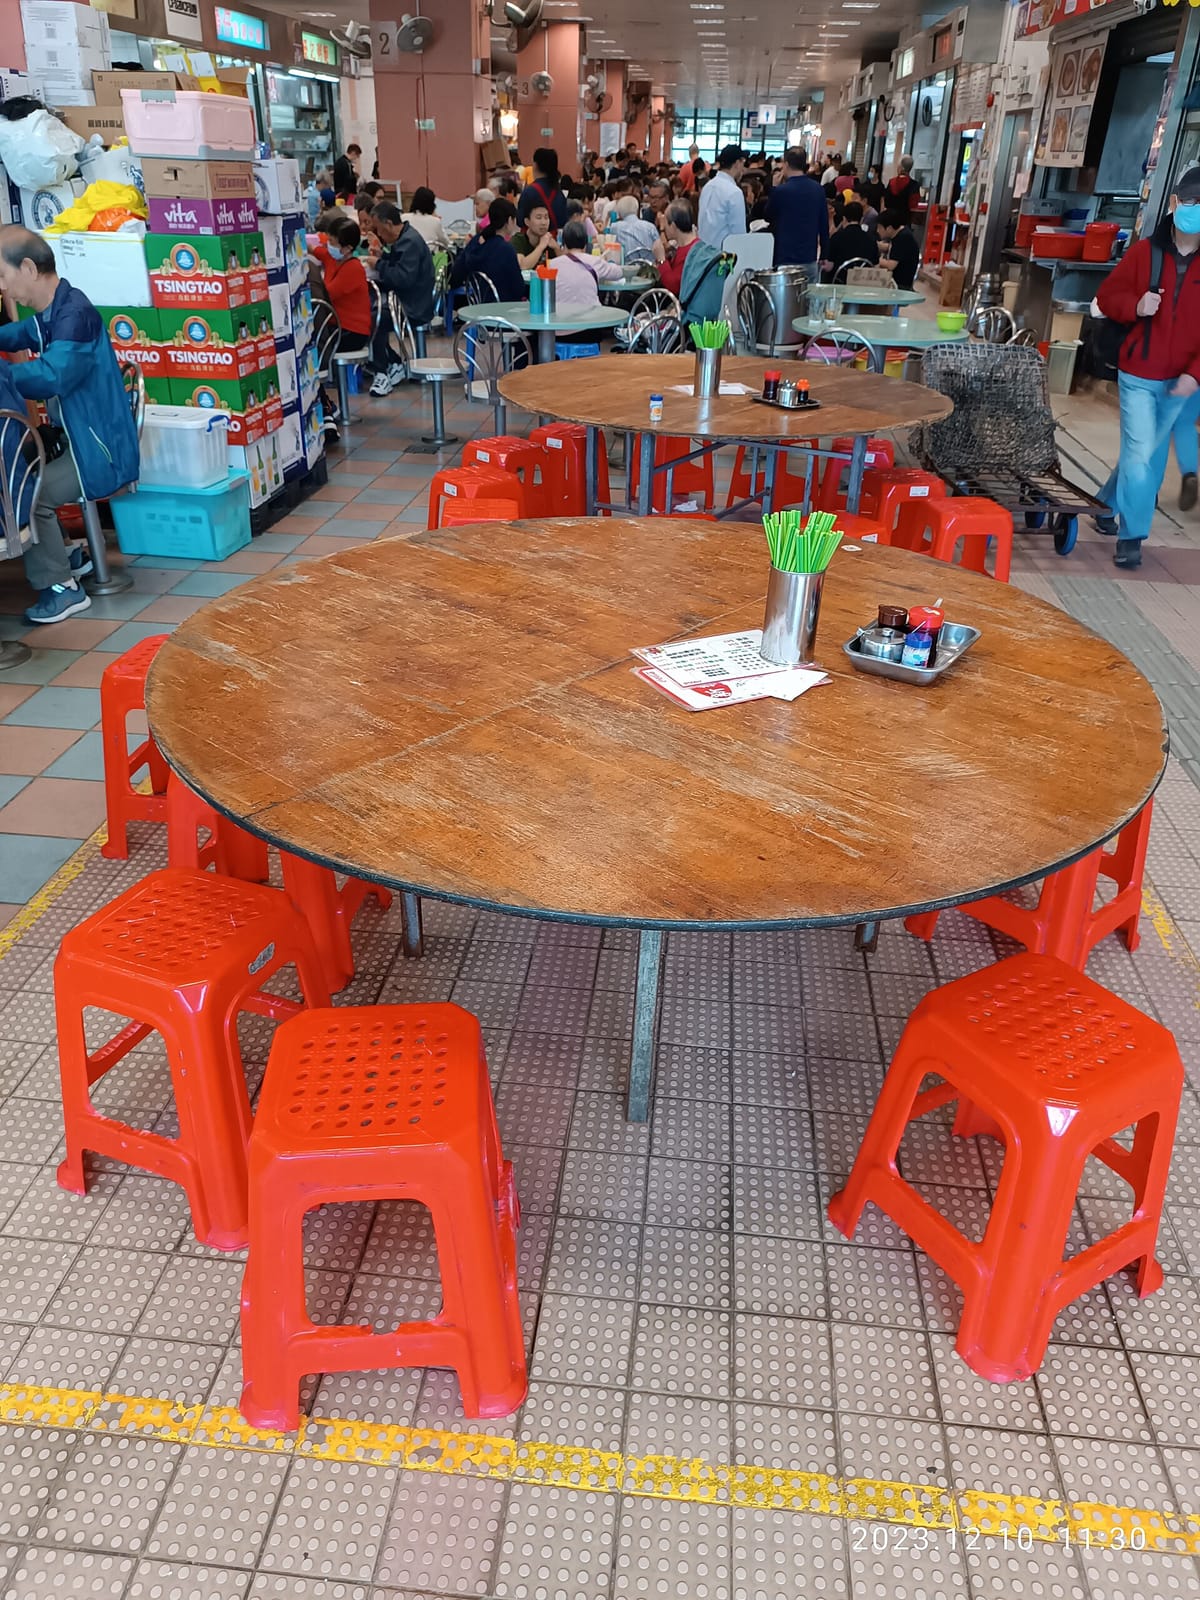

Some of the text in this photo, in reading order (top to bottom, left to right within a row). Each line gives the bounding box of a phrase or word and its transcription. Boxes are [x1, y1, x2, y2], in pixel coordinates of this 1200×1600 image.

[379, 32, 390, 55] 2
[522, 82, 529, 95] 3
[164, 202, 197, 223] vita
[217, 202, 235, 224] vita
[238, 201, 255, 223] vita
[154, 280, 223, 294] TSINGTAO
[116, 349, 160, 363] NGTAO
[167, 350, 233, 365] TSINGTAO
